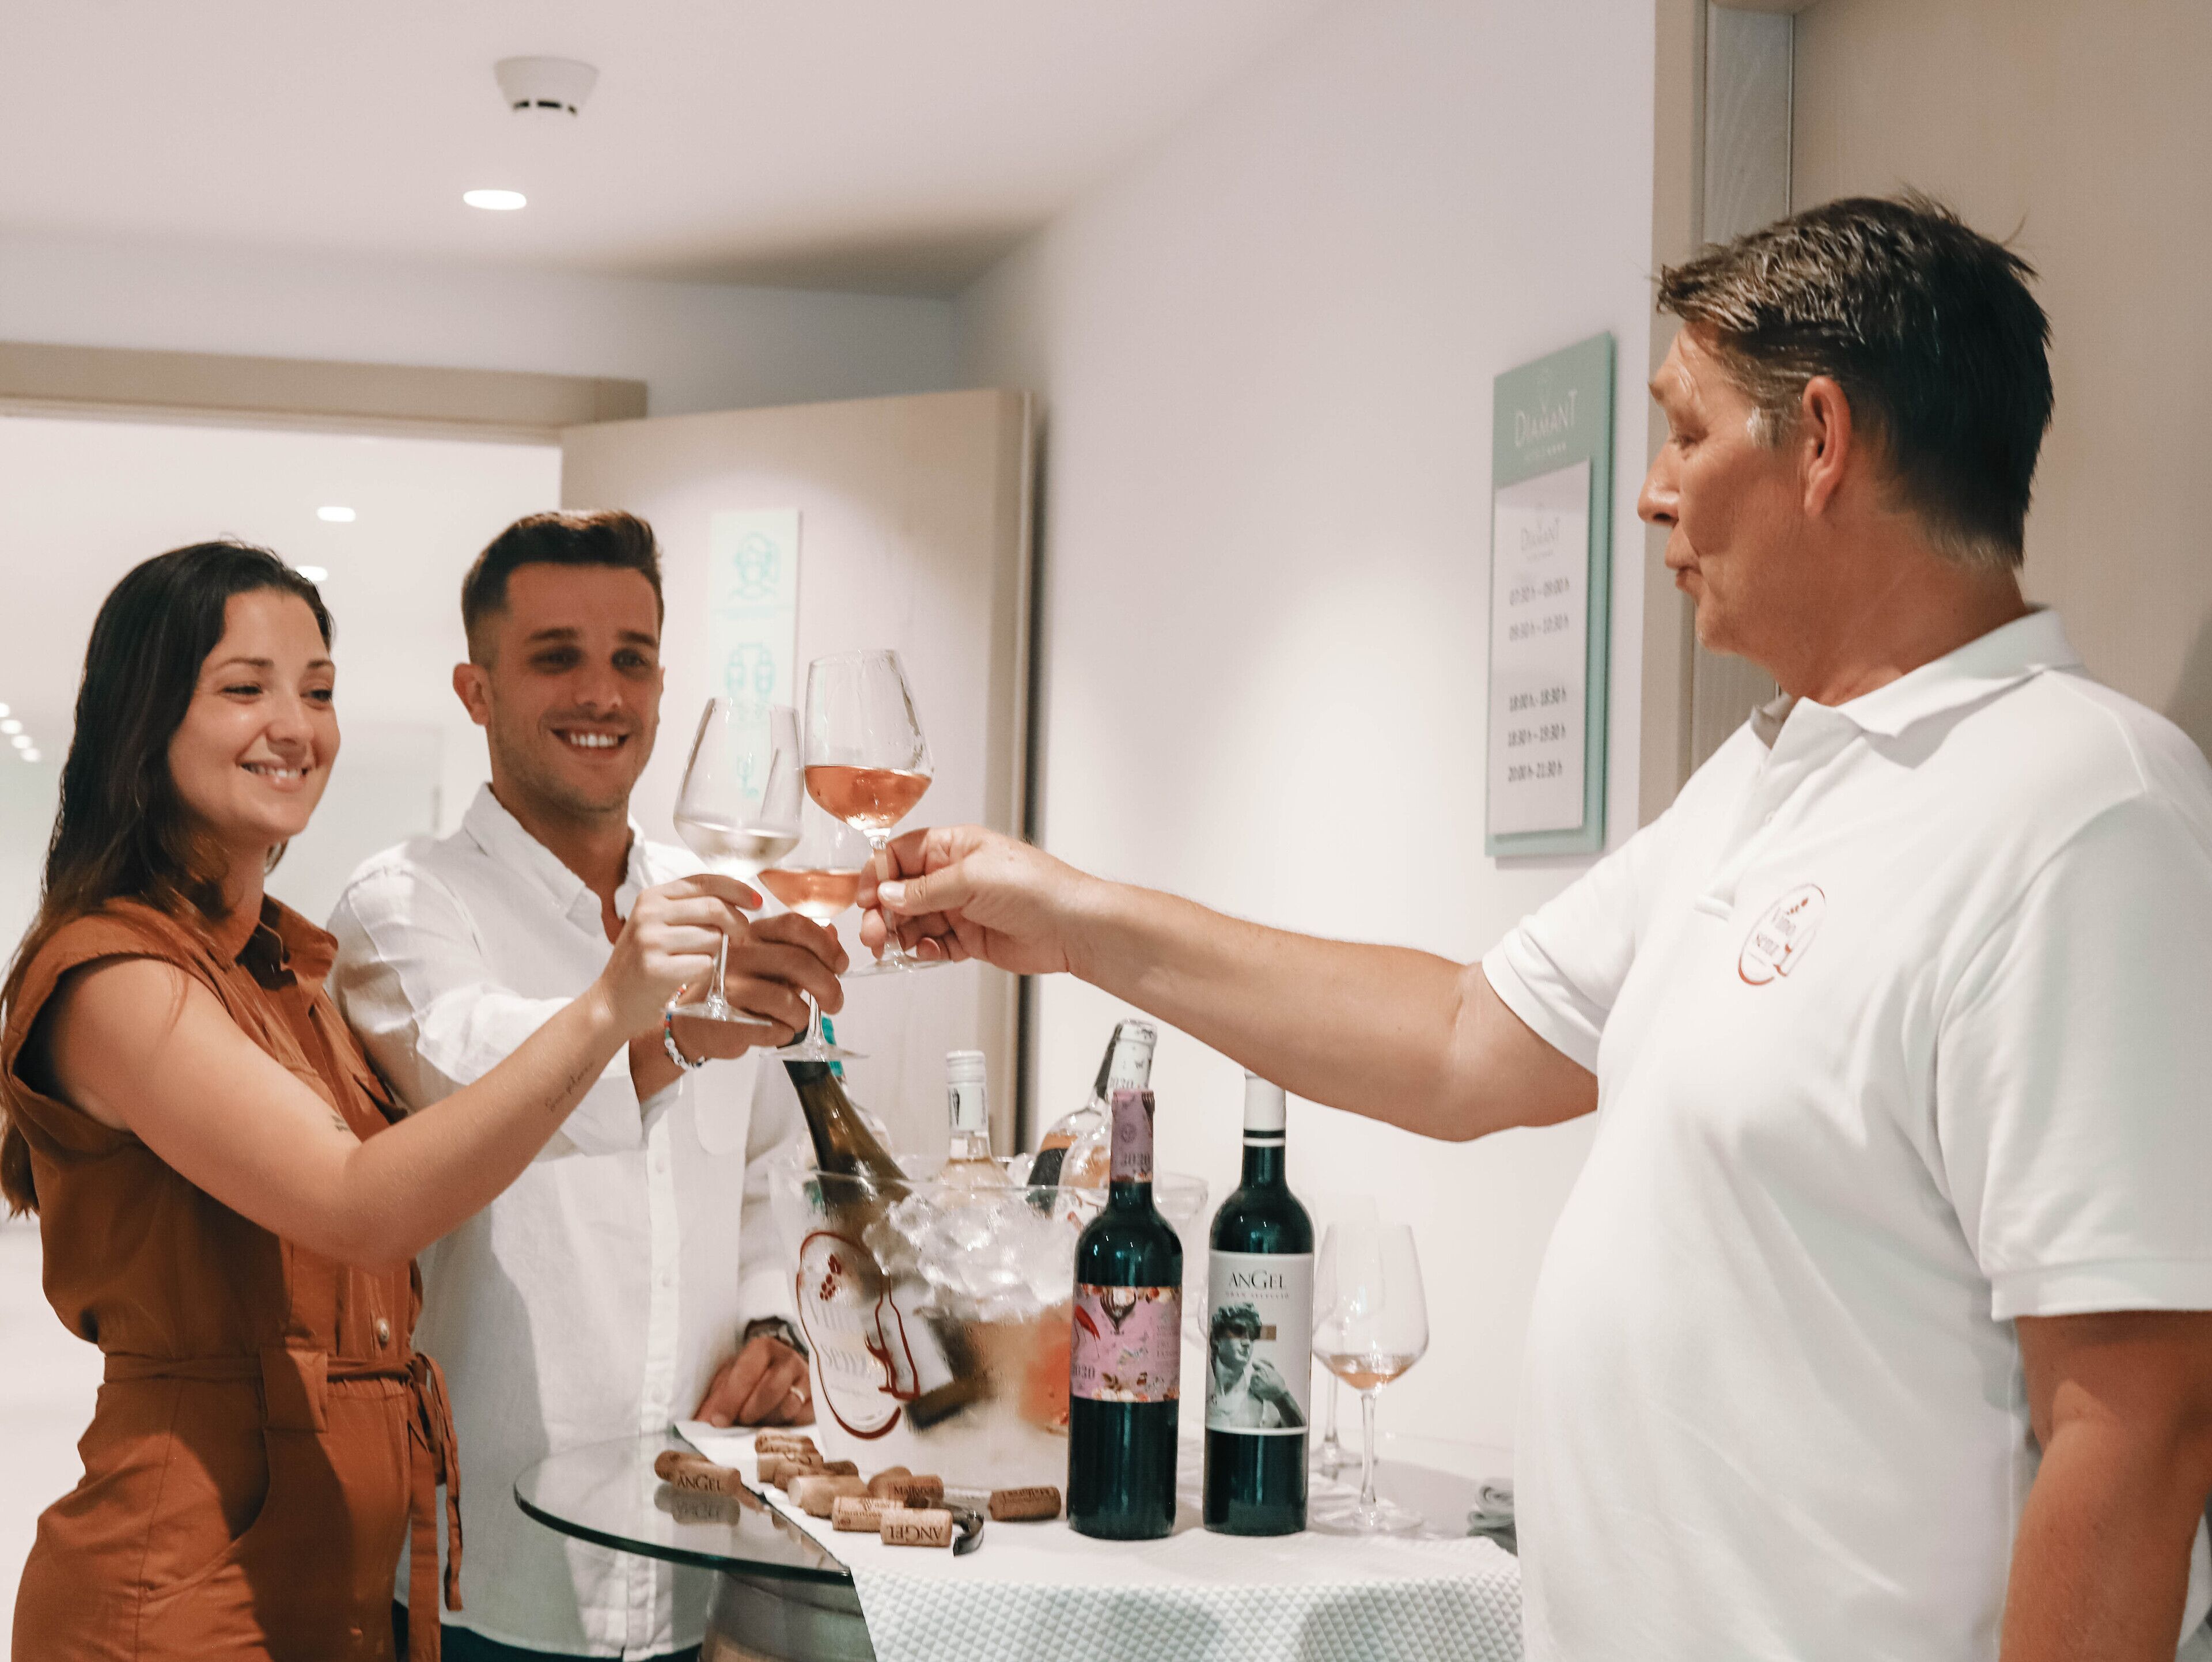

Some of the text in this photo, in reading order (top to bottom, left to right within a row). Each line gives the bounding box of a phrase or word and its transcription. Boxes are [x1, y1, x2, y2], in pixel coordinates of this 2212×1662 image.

[1229, 1269, 1287, 1290] ANGEL
[677, 1474, 722, 1491] ANGEL
[887, 1524, 942, 1542] ANGEL
